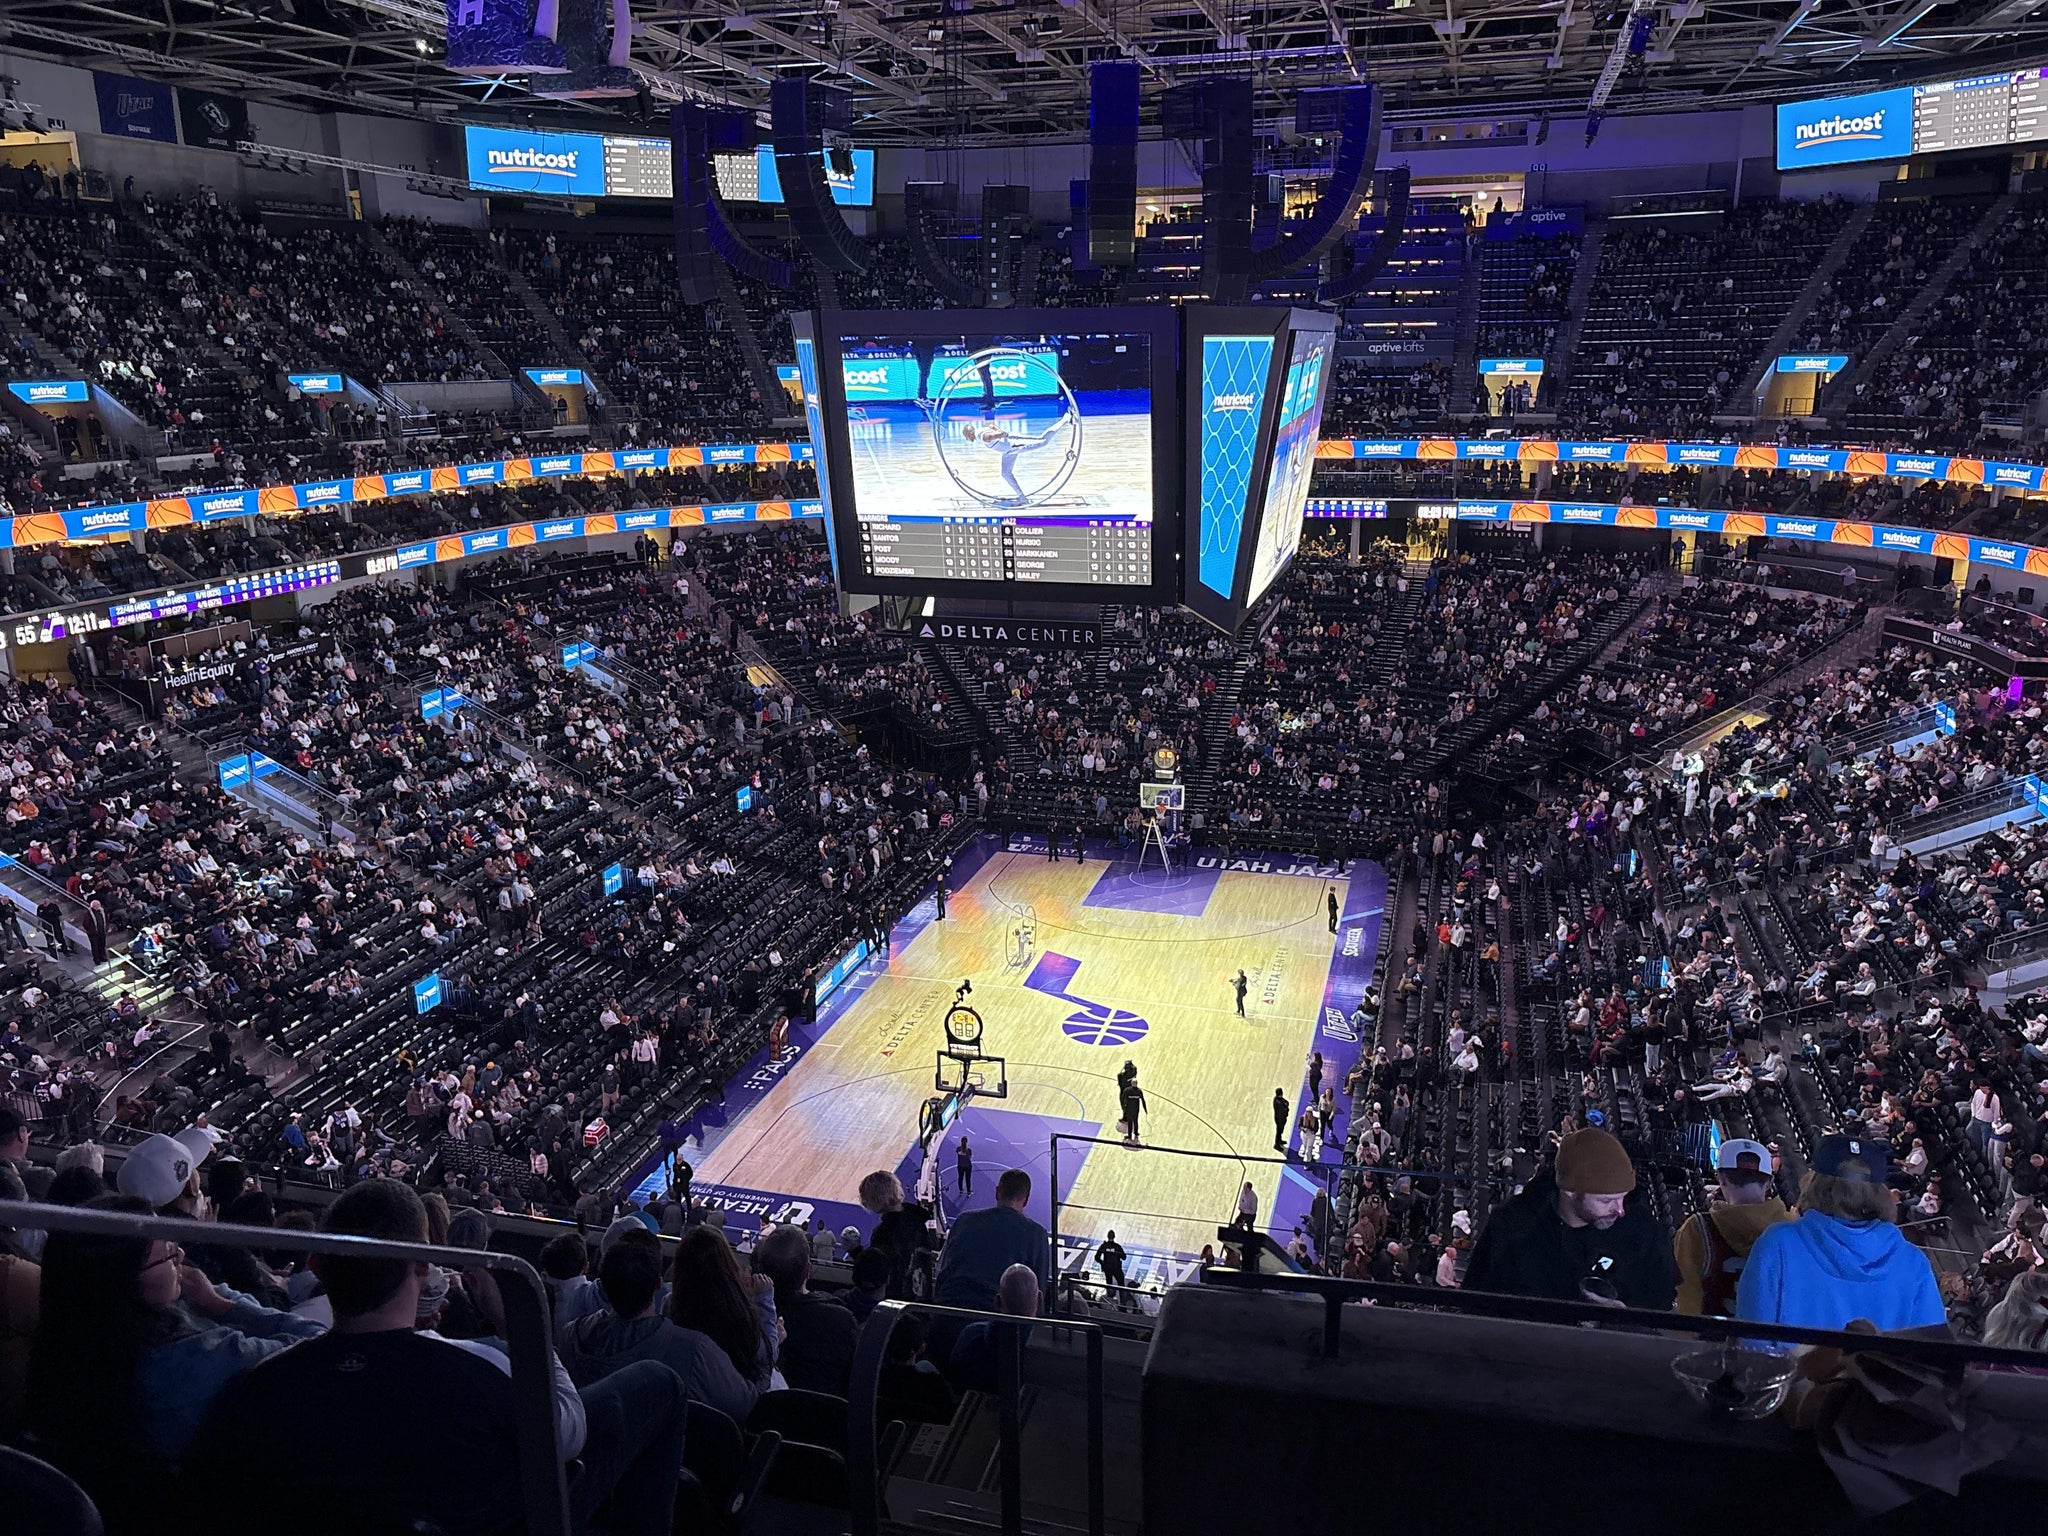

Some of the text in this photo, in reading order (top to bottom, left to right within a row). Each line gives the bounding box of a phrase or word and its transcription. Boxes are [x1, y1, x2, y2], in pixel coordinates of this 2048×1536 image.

[2023, 69, 2040, 80] JAZZ
[1796, 110, 1884, 139] nutricost
[488, 147, 578, 168] nutricost
[1531, 210, 1566, 223] aptive
[1368, 342, 1425, 354] aptive lofts
[1795, 358, 1829, 367] nutricost
[30, 385, 67, 395] nutricost
[1214, 392, 1255, 406] nutricost
[1364, 443, 1402, 453] nutricost
[1467, 443, 1506, 454] nutricost
[1572, 445, 1612, 456] nutricost
[1680, 447, 1721, 459] nutricost
[623, 452, 654, 463] nutricost
[710, 449, 745, 460] nutricost
[1790, 452, 1831, 463] nutricost
[540, 458, 570, 470] nutricost
[1896, 458, 1937, 470] nutricost
[467, 466, 494, 478] nutricost
[1996, 467, 2033, 480] nutricost
[393, 474, 422, 487] nutricost
[306, 485, 340, 498] nutricost
[204, 496, 244, 510] nutricost
[712, 507, 745, 518] nutricost
[1444, 506, 1456, 518] PM
[1459, 504, 1497, 515] nutricost
[1563, 508, 1603, 519] nutricost
[82, 509, 129, 526] nutricost
[625, 514, 656, 525] nutricost
[1669, 513, 1710, 524] nutricost
[544, 522, 574, 534] nutricost
[872, 523, 901, 531] RICHARD
[1777, 521, 1818, 533] nutricost
[471, 534, 498, 546] nutricost
[873, 534, 899, 542] SANTOS
[1883, 532, 1922, 544] nutricost
[399, 547, 427, 560] nutricost
[1016, 550, 1058, 558] MARKKANEN
[1981, 545, 2017, 560] nutricost
[386, 555, 398, 571] PM
[67, 612, 97, 635] 12:11
[16, 625, 36, 645] 55
[941, 624, 1095, 643] DELTA CENTER
[1941, 634, 1957, 645] HEALTH
[1957, 639, 1971, 649] PLANS
[287, 642, 319, 656] AMERICA FIRST
[164, 662, 237, 689] HealthEquity
[1197, 857, 1352, 880] UTAH JAZZ
[1264, 947, 1288, 998] DELTA CENTER
[887, 1020, 918, 1048] DELTA
[917, 990, 940, 1019] CENTER
[1322, 1007, 1358, 1042] UTAH
[714, 1190, 726, 1198] OF
[726, 1191, 775, 1203] UNIVERSITY
